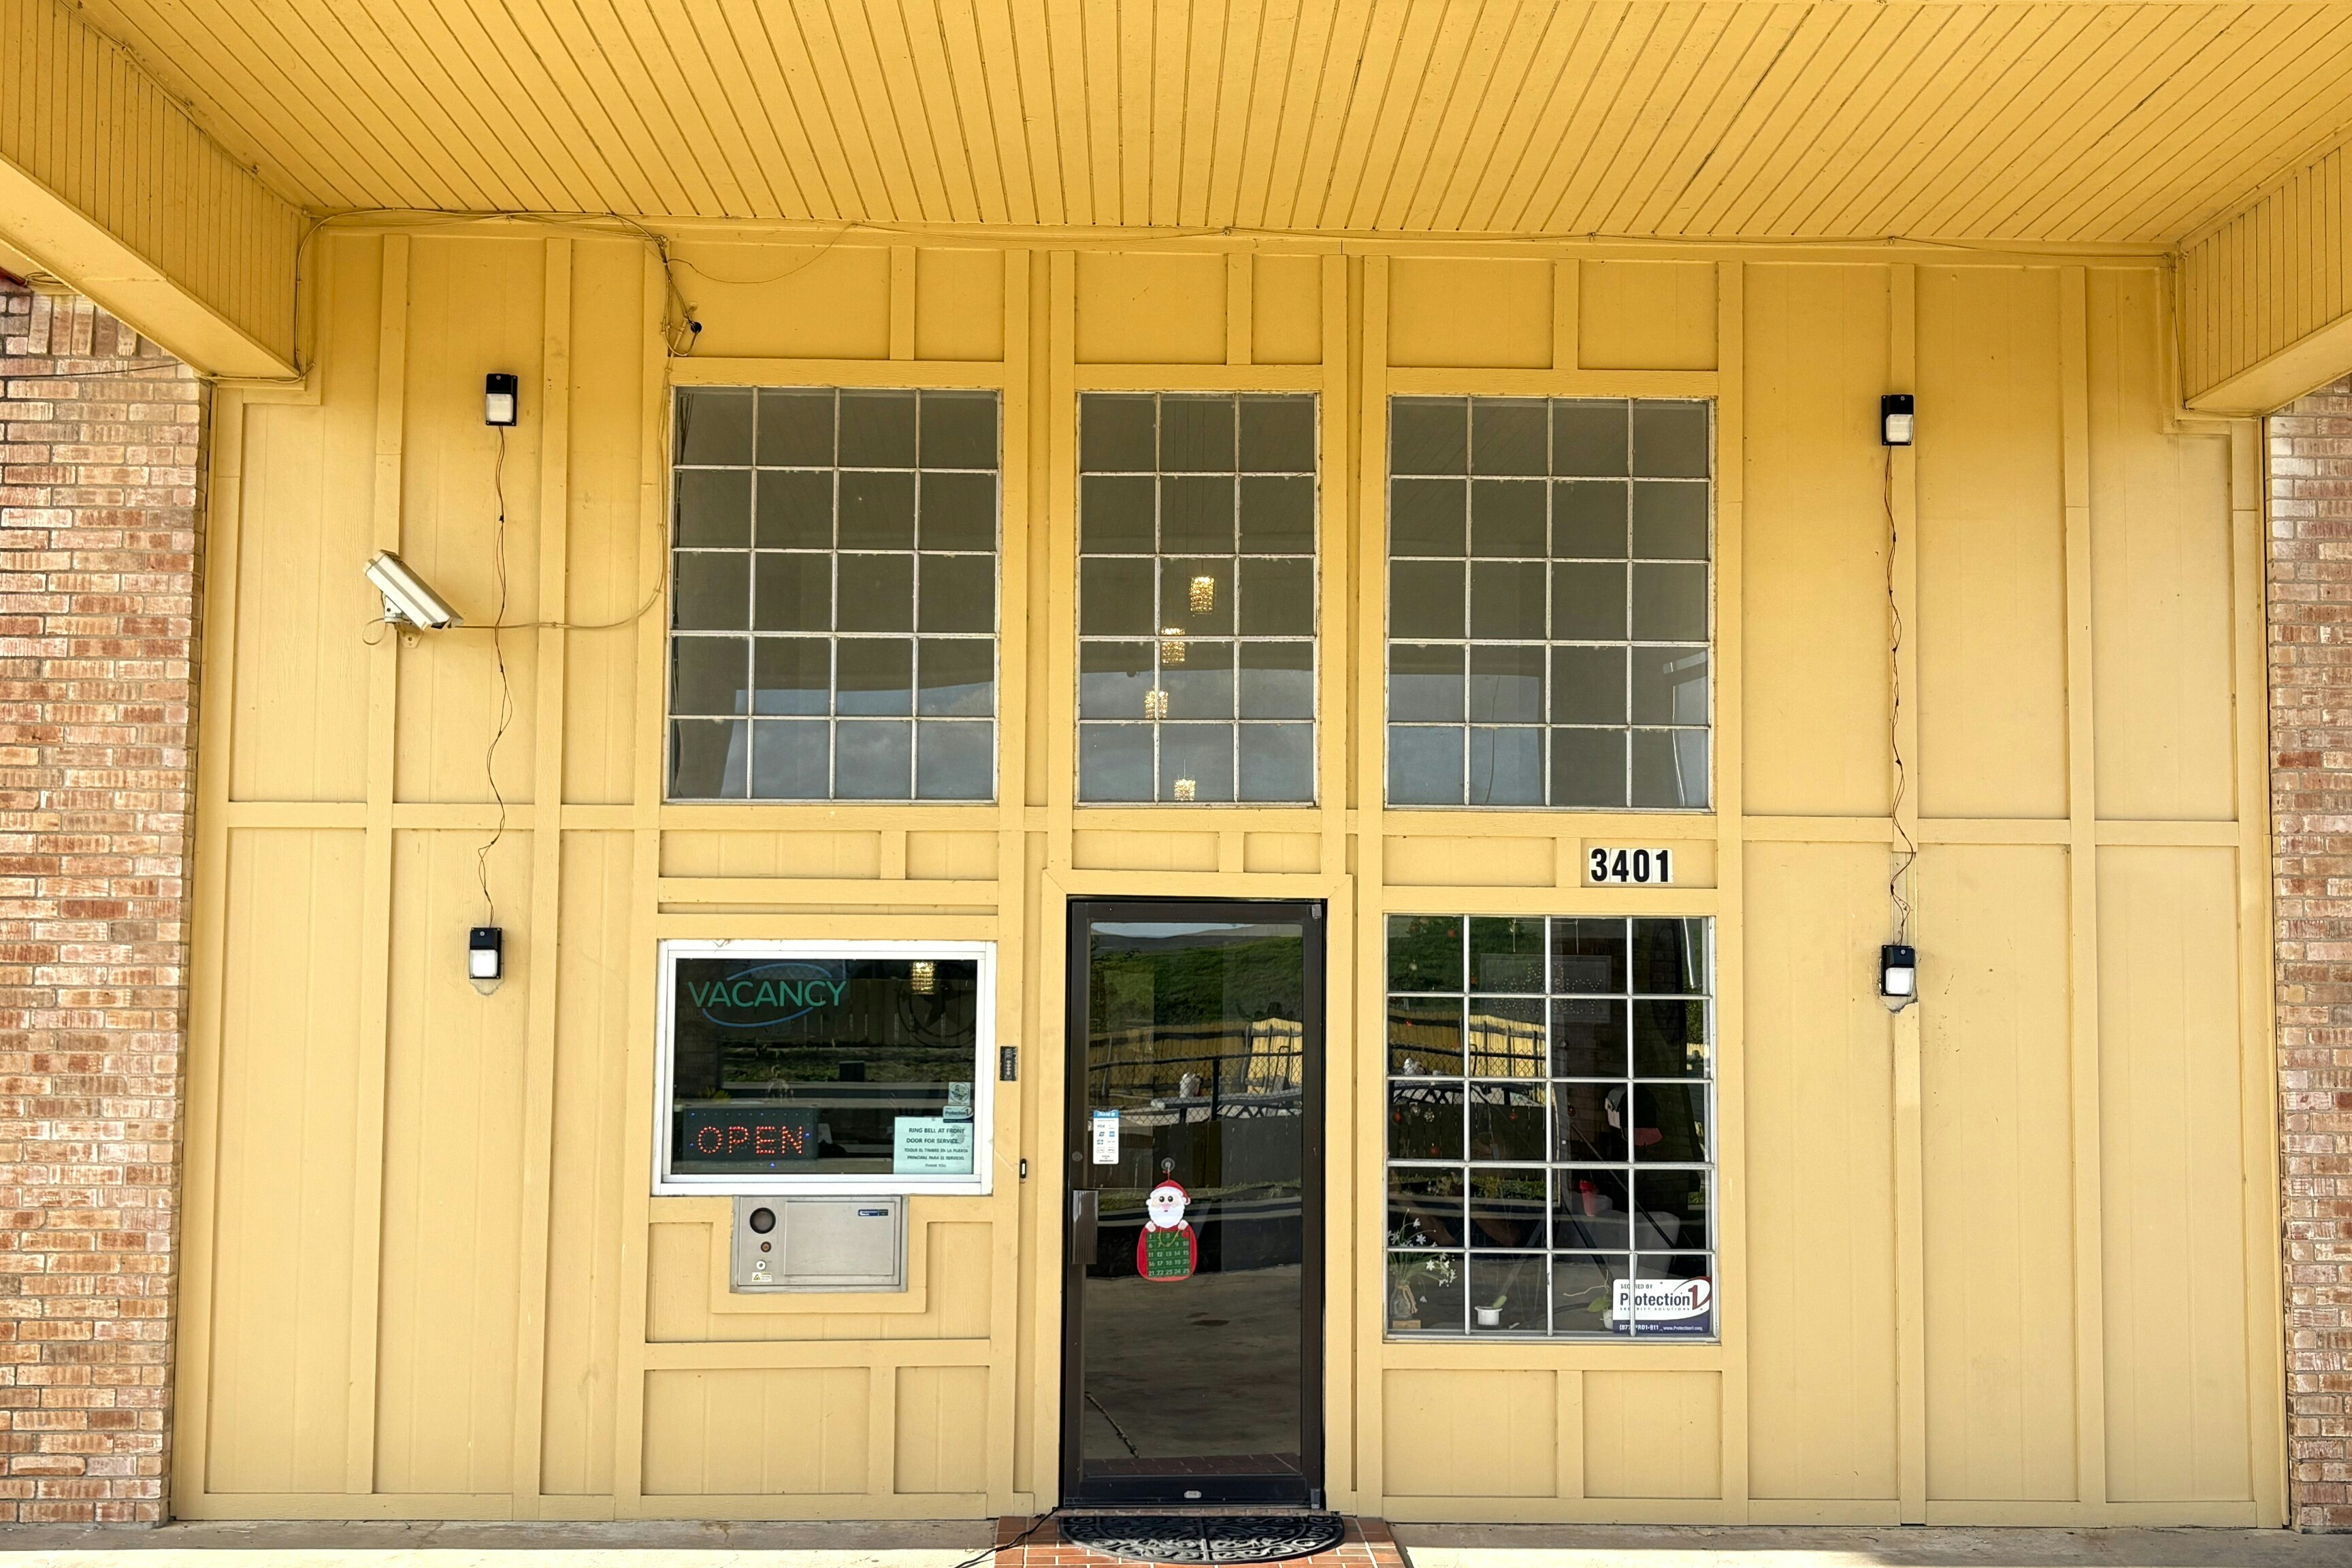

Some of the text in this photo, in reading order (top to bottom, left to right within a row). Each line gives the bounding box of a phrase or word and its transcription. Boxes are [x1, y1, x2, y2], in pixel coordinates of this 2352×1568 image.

[1591, 848, 1668, 882] 3401
[688, 980, 847, 1007] VACANCY
[698, 1126, 803, 1154] OPEN
